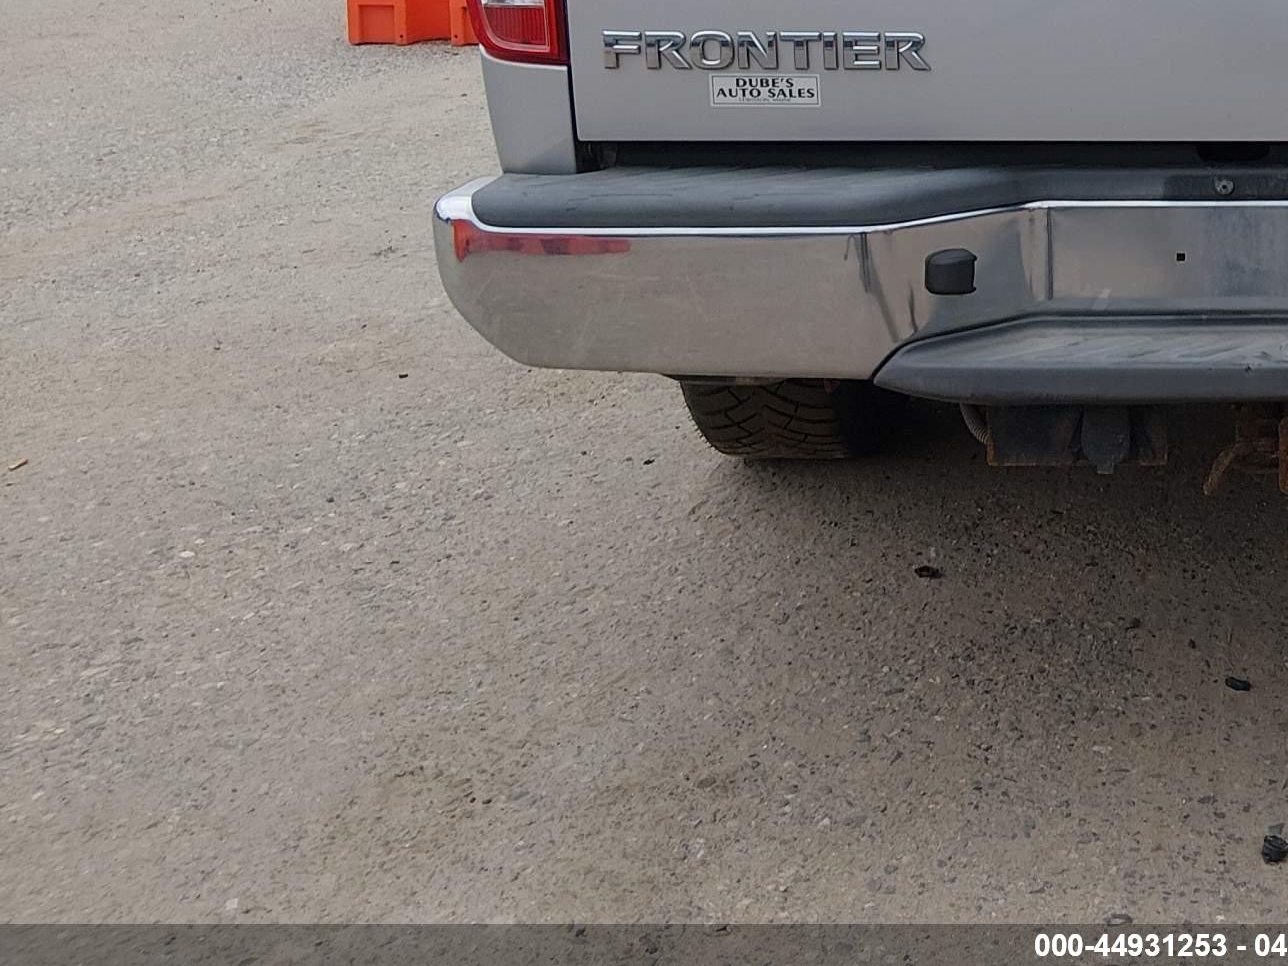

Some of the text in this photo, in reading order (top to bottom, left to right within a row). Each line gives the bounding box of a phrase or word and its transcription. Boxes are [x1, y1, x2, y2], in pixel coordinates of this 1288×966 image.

[602, 29, 932, 72] FRONTIER
[735, 77, 794, 88] DUBE'S
[716, 88, 815, 98] AUTO SALES
